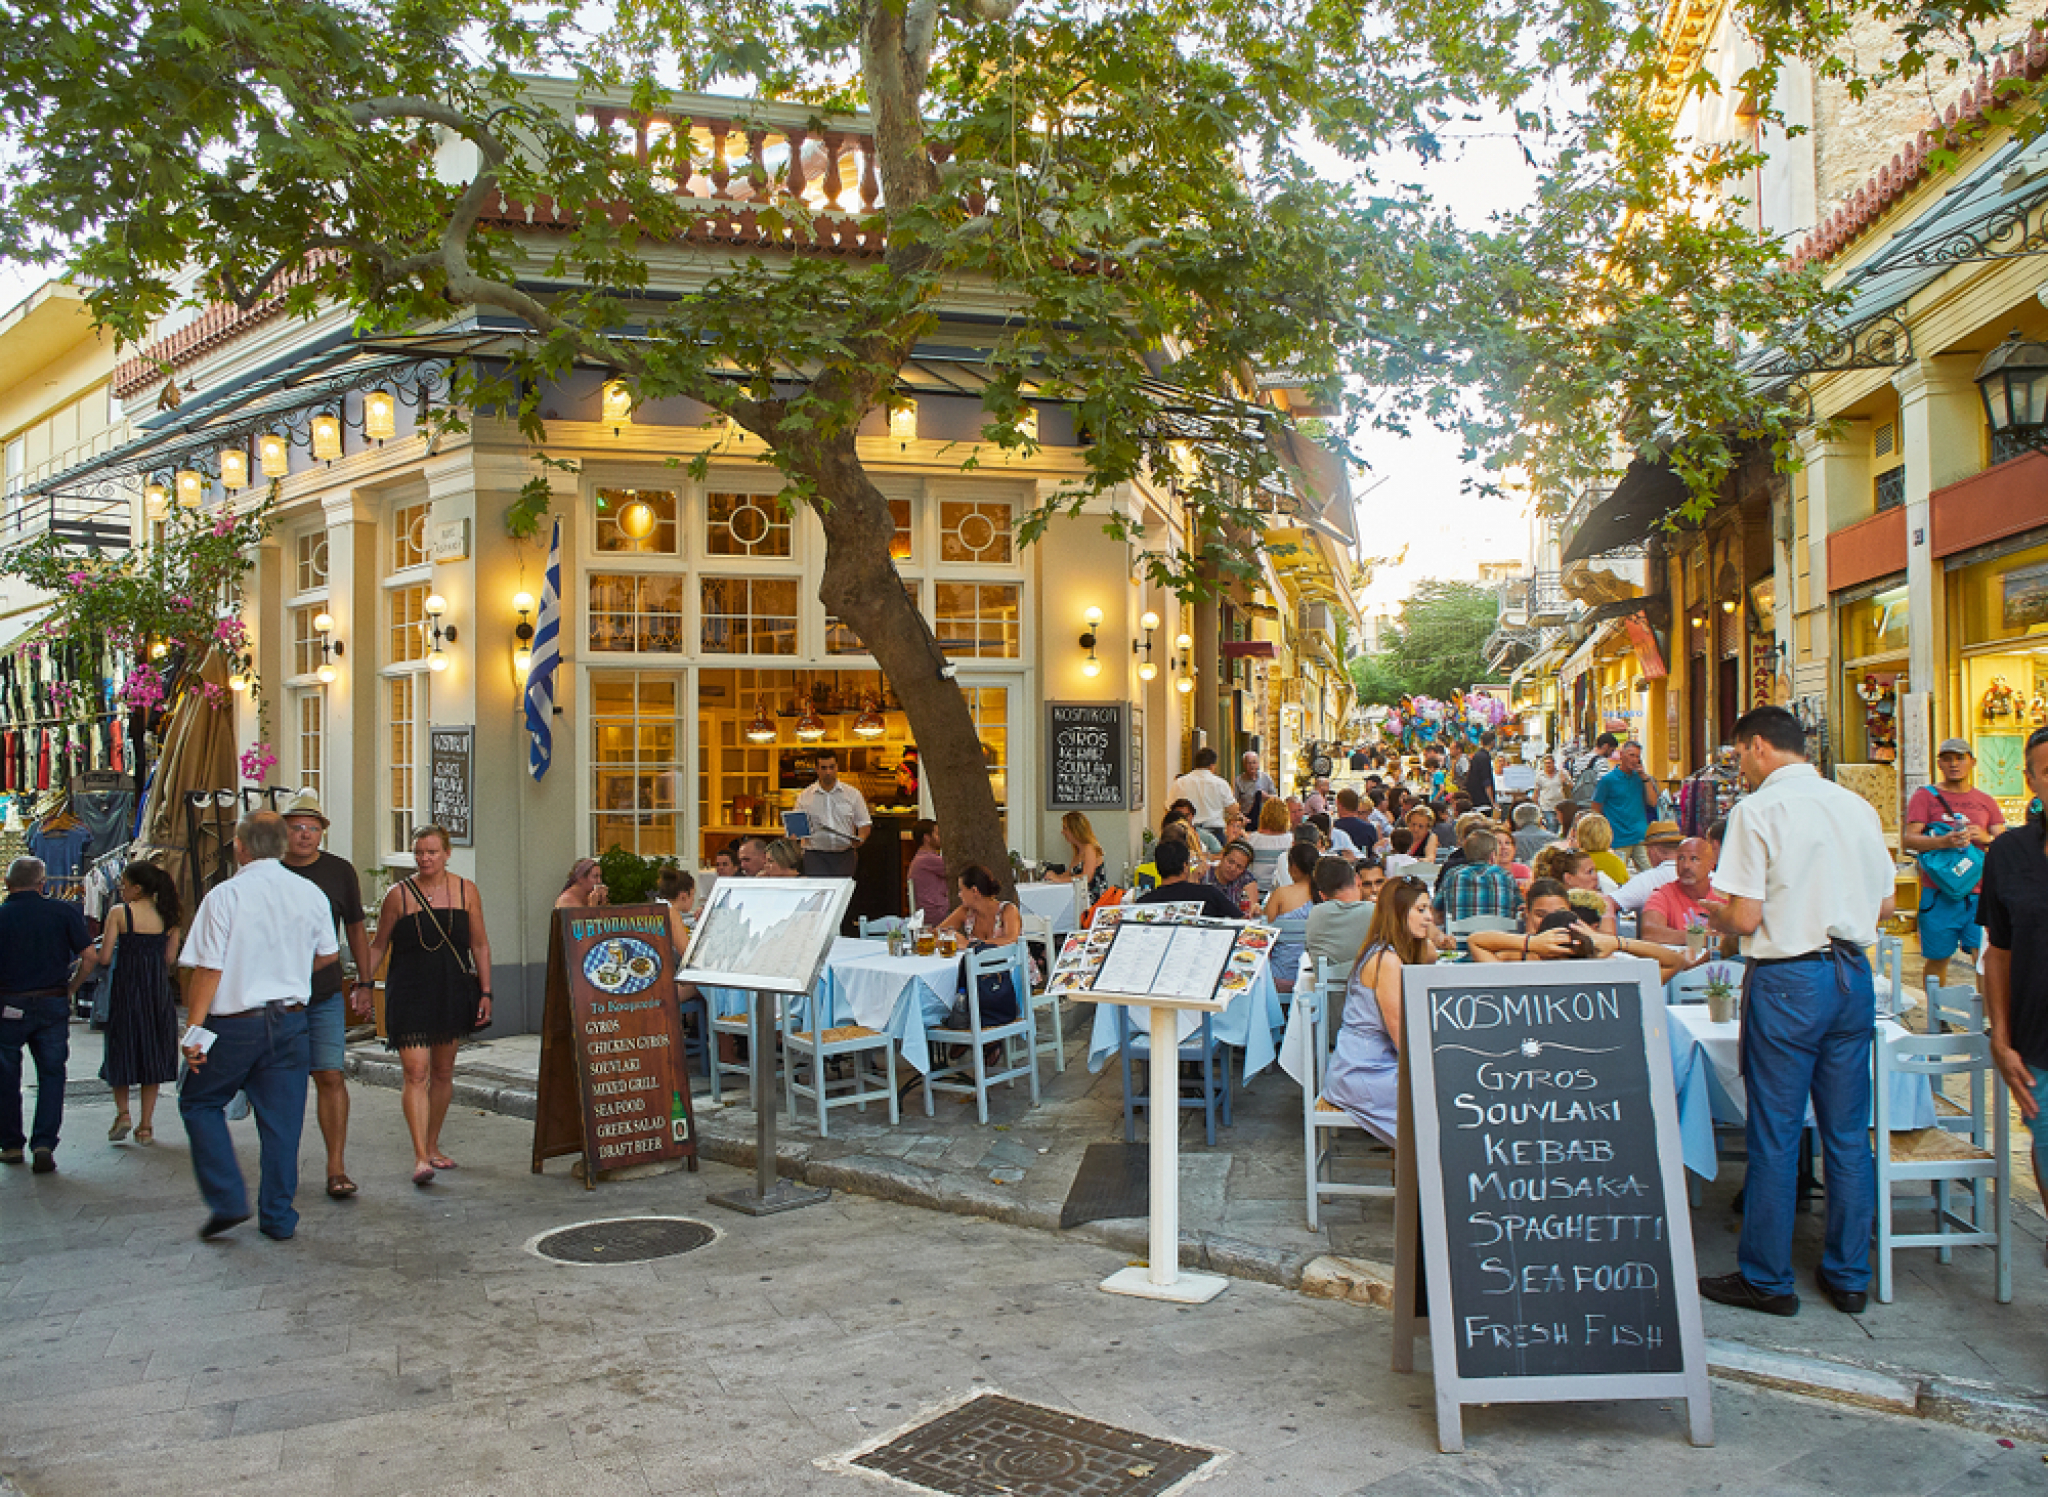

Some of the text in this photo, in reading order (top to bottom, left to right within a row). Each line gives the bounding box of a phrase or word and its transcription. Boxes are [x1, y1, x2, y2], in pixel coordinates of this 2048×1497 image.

[1431, 988, 1620, 1032] KOSMIKON
[585, 1019, 620, 1035] GYROS
[588, 1033, 670, 1056] CHICKEN GYROS
[589, 1058, 641, 1076] SOUVLAKI
[591, 1076, 660, 1096] MIXED GRILL
[596, 1115, 666, 1138] GREEK SALAD
[598, 1136, 663, 1159] DRAFT BEER
